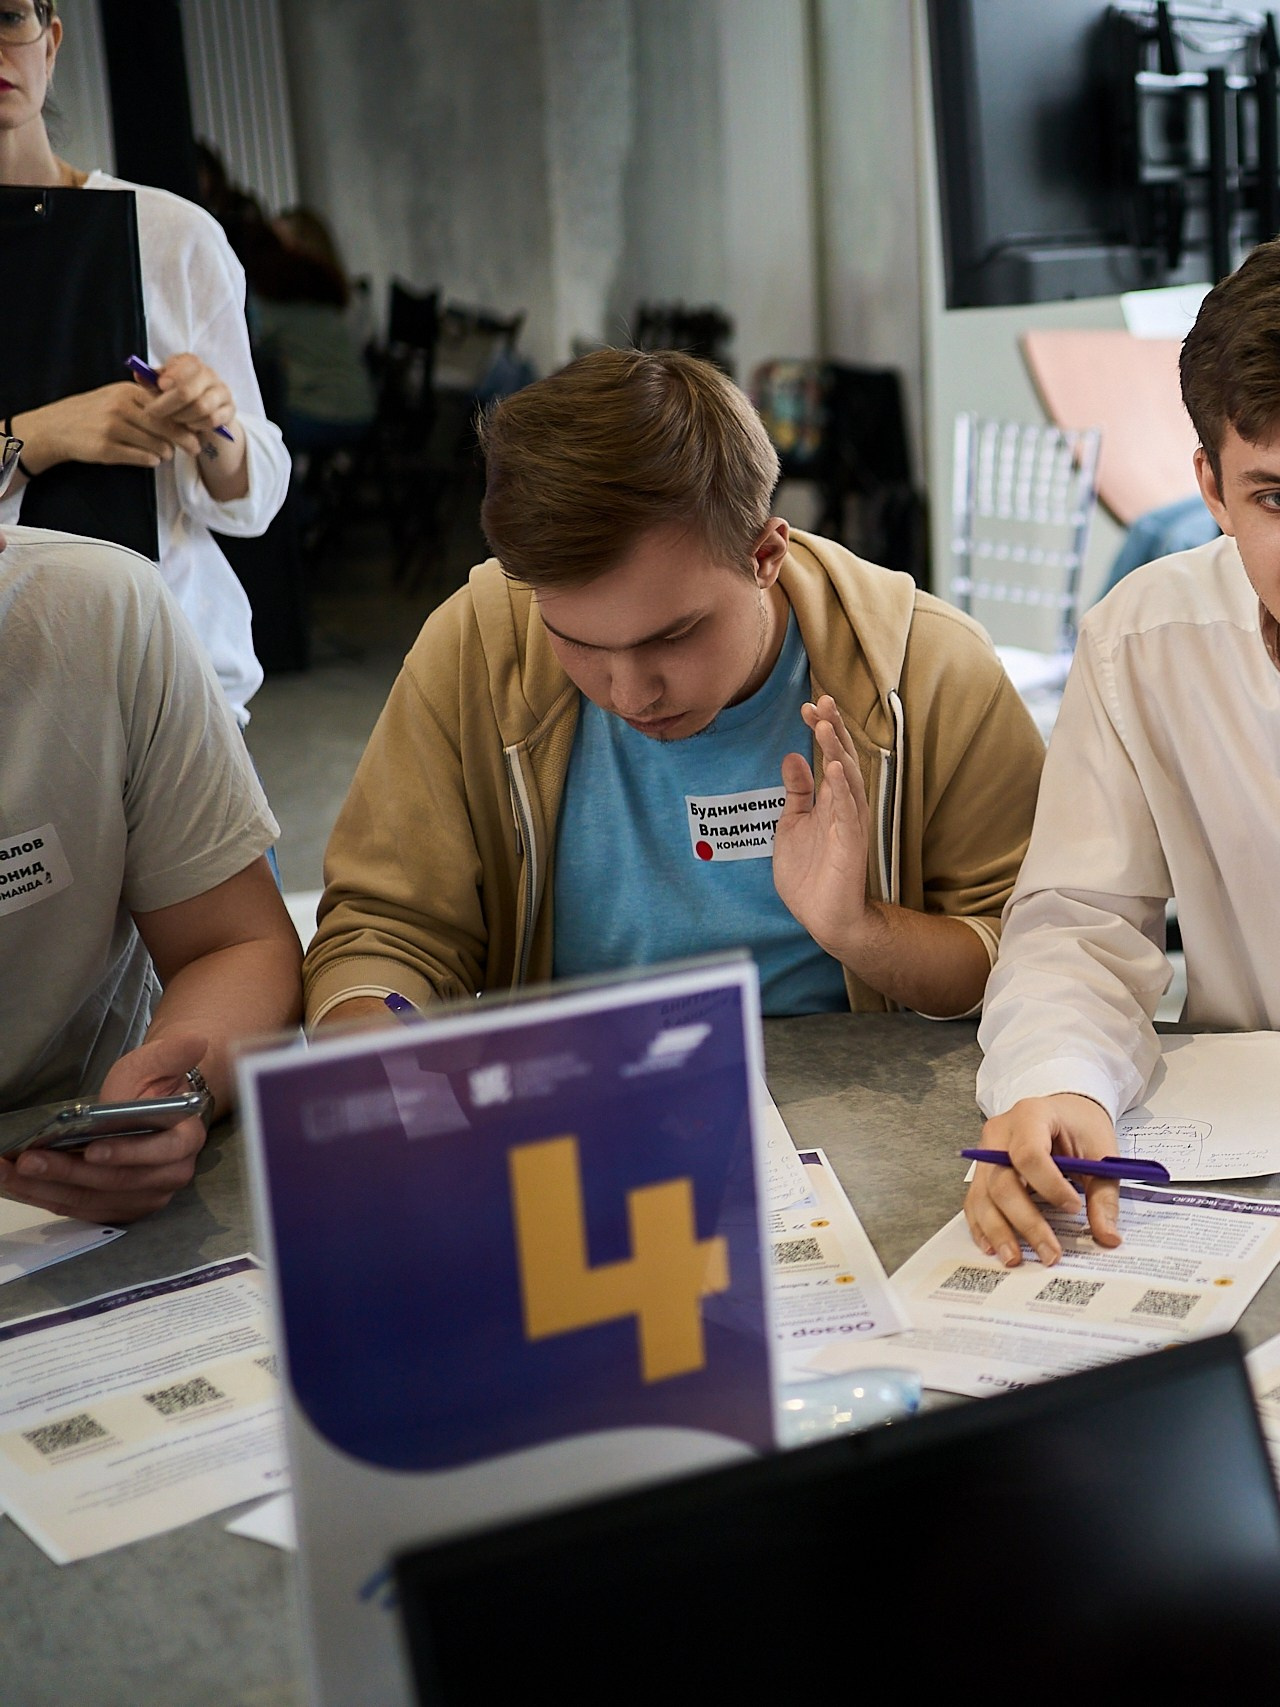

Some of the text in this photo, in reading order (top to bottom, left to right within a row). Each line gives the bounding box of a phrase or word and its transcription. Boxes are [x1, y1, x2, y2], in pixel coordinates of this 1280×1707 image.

[690, 797, 785, 820] Будниченко
[717, 837, 767, 850] КОМАНДА
[508, 1133, 731, 1386] 4
